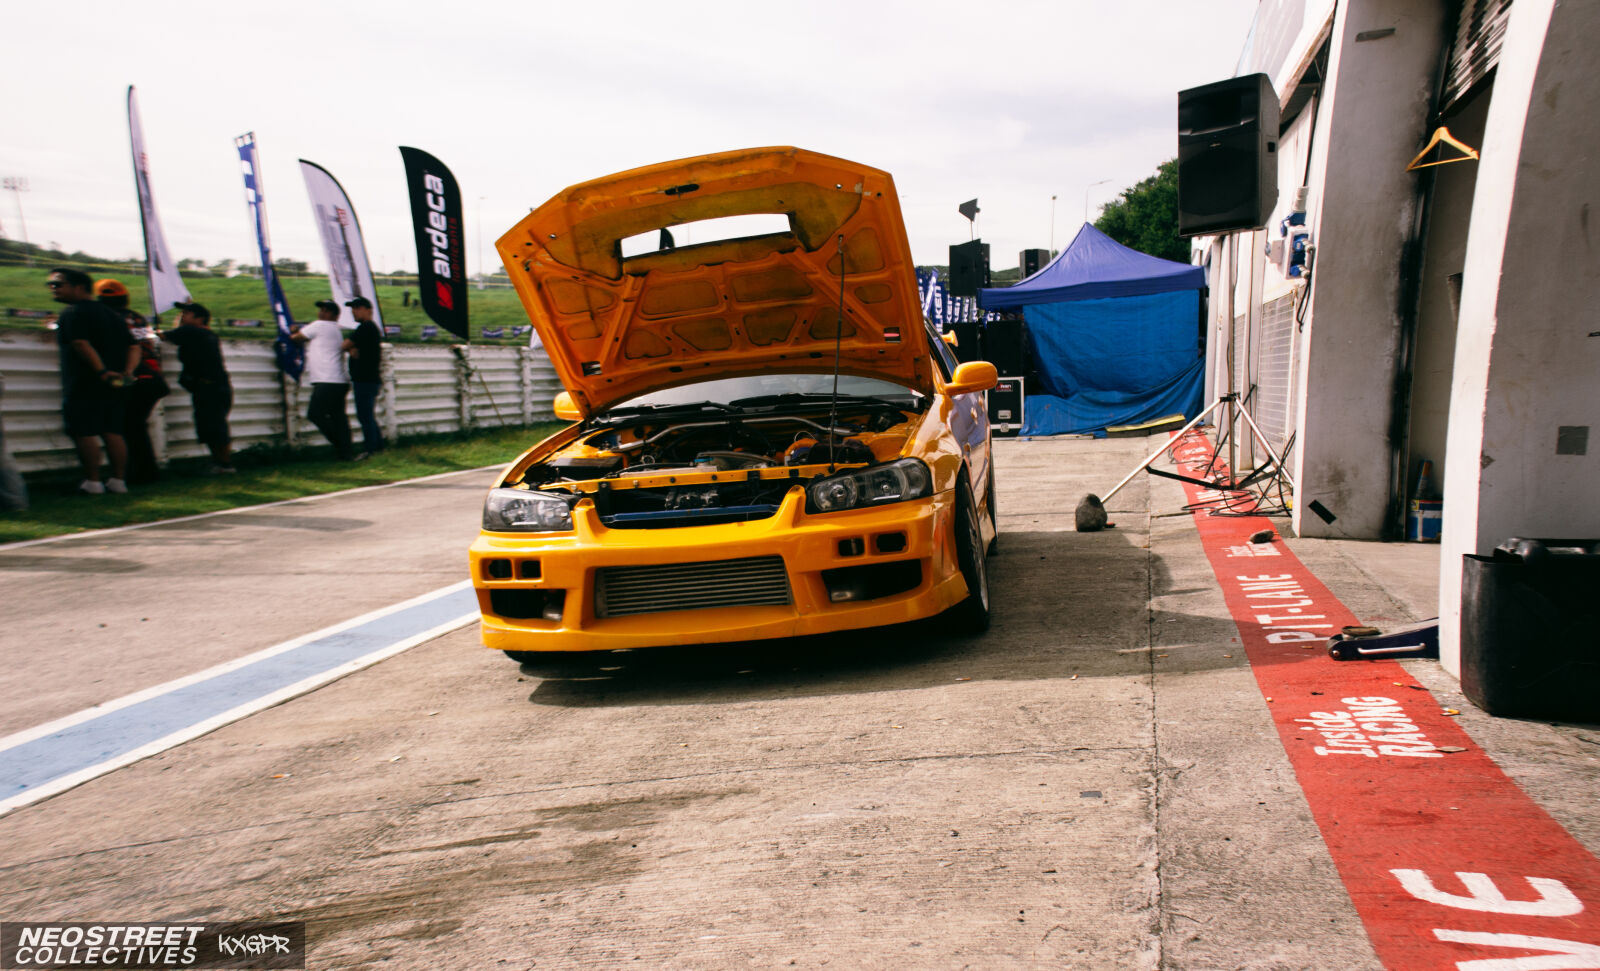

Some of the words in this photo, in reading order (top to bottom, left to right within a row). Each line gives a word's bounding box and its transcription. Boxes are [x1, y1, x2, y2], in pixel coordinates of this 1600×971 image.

[424, 173, 452, 279] ardeca
[1236, 574, 1333, 644] PIT-LANE
[1294, 710, 1379, 758] Inside
[1341, 696, 1444, 758] RACING
